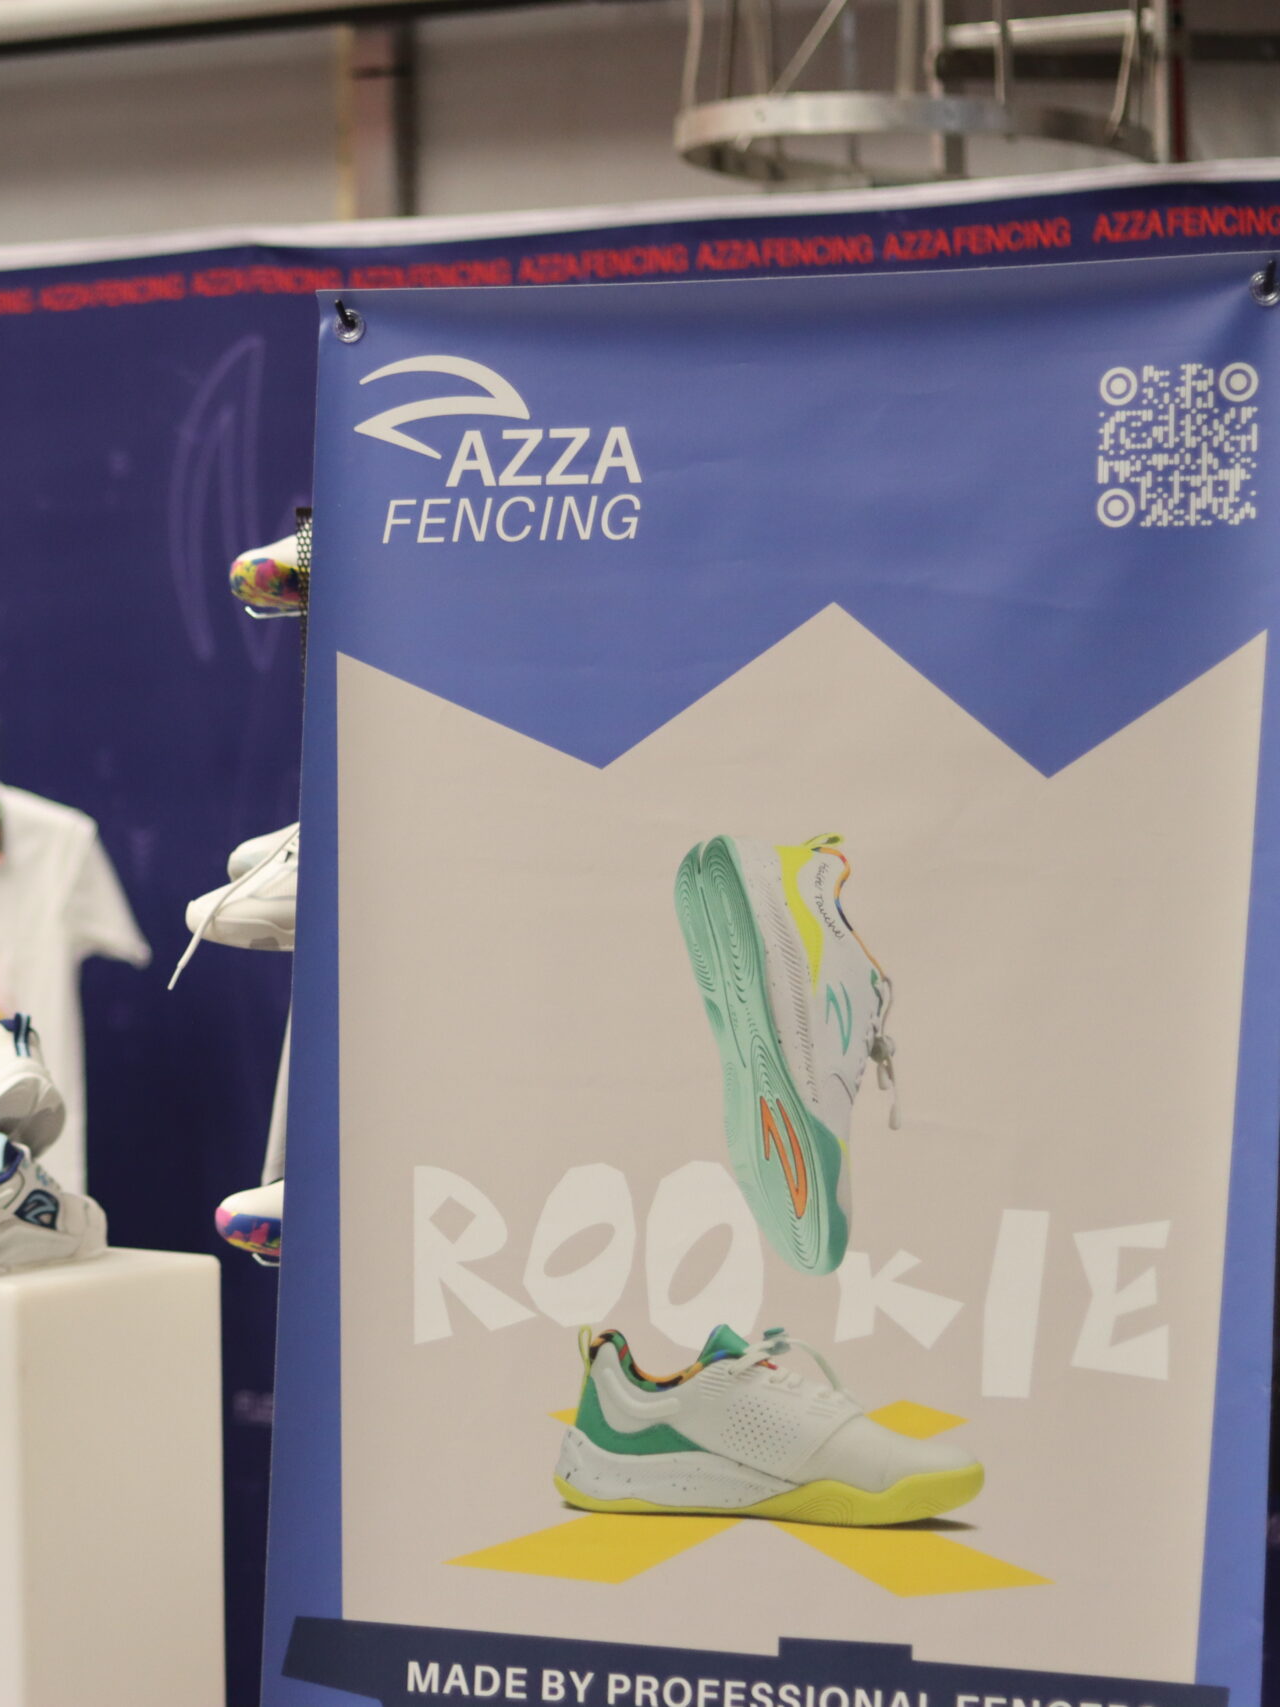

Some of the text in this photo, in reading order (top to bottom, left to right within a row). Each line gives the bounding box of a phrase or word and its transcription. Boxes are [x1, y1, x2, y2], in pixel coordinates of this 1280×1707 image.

[445, 426, 643, 488] AZZA
[382, 493, 642, 545] FENCING
[414, 1160, 1172, 1399] ROOKIE
[407, 1661, 528, 1699] MADE
[541, 1668, 595, 1703] BY
